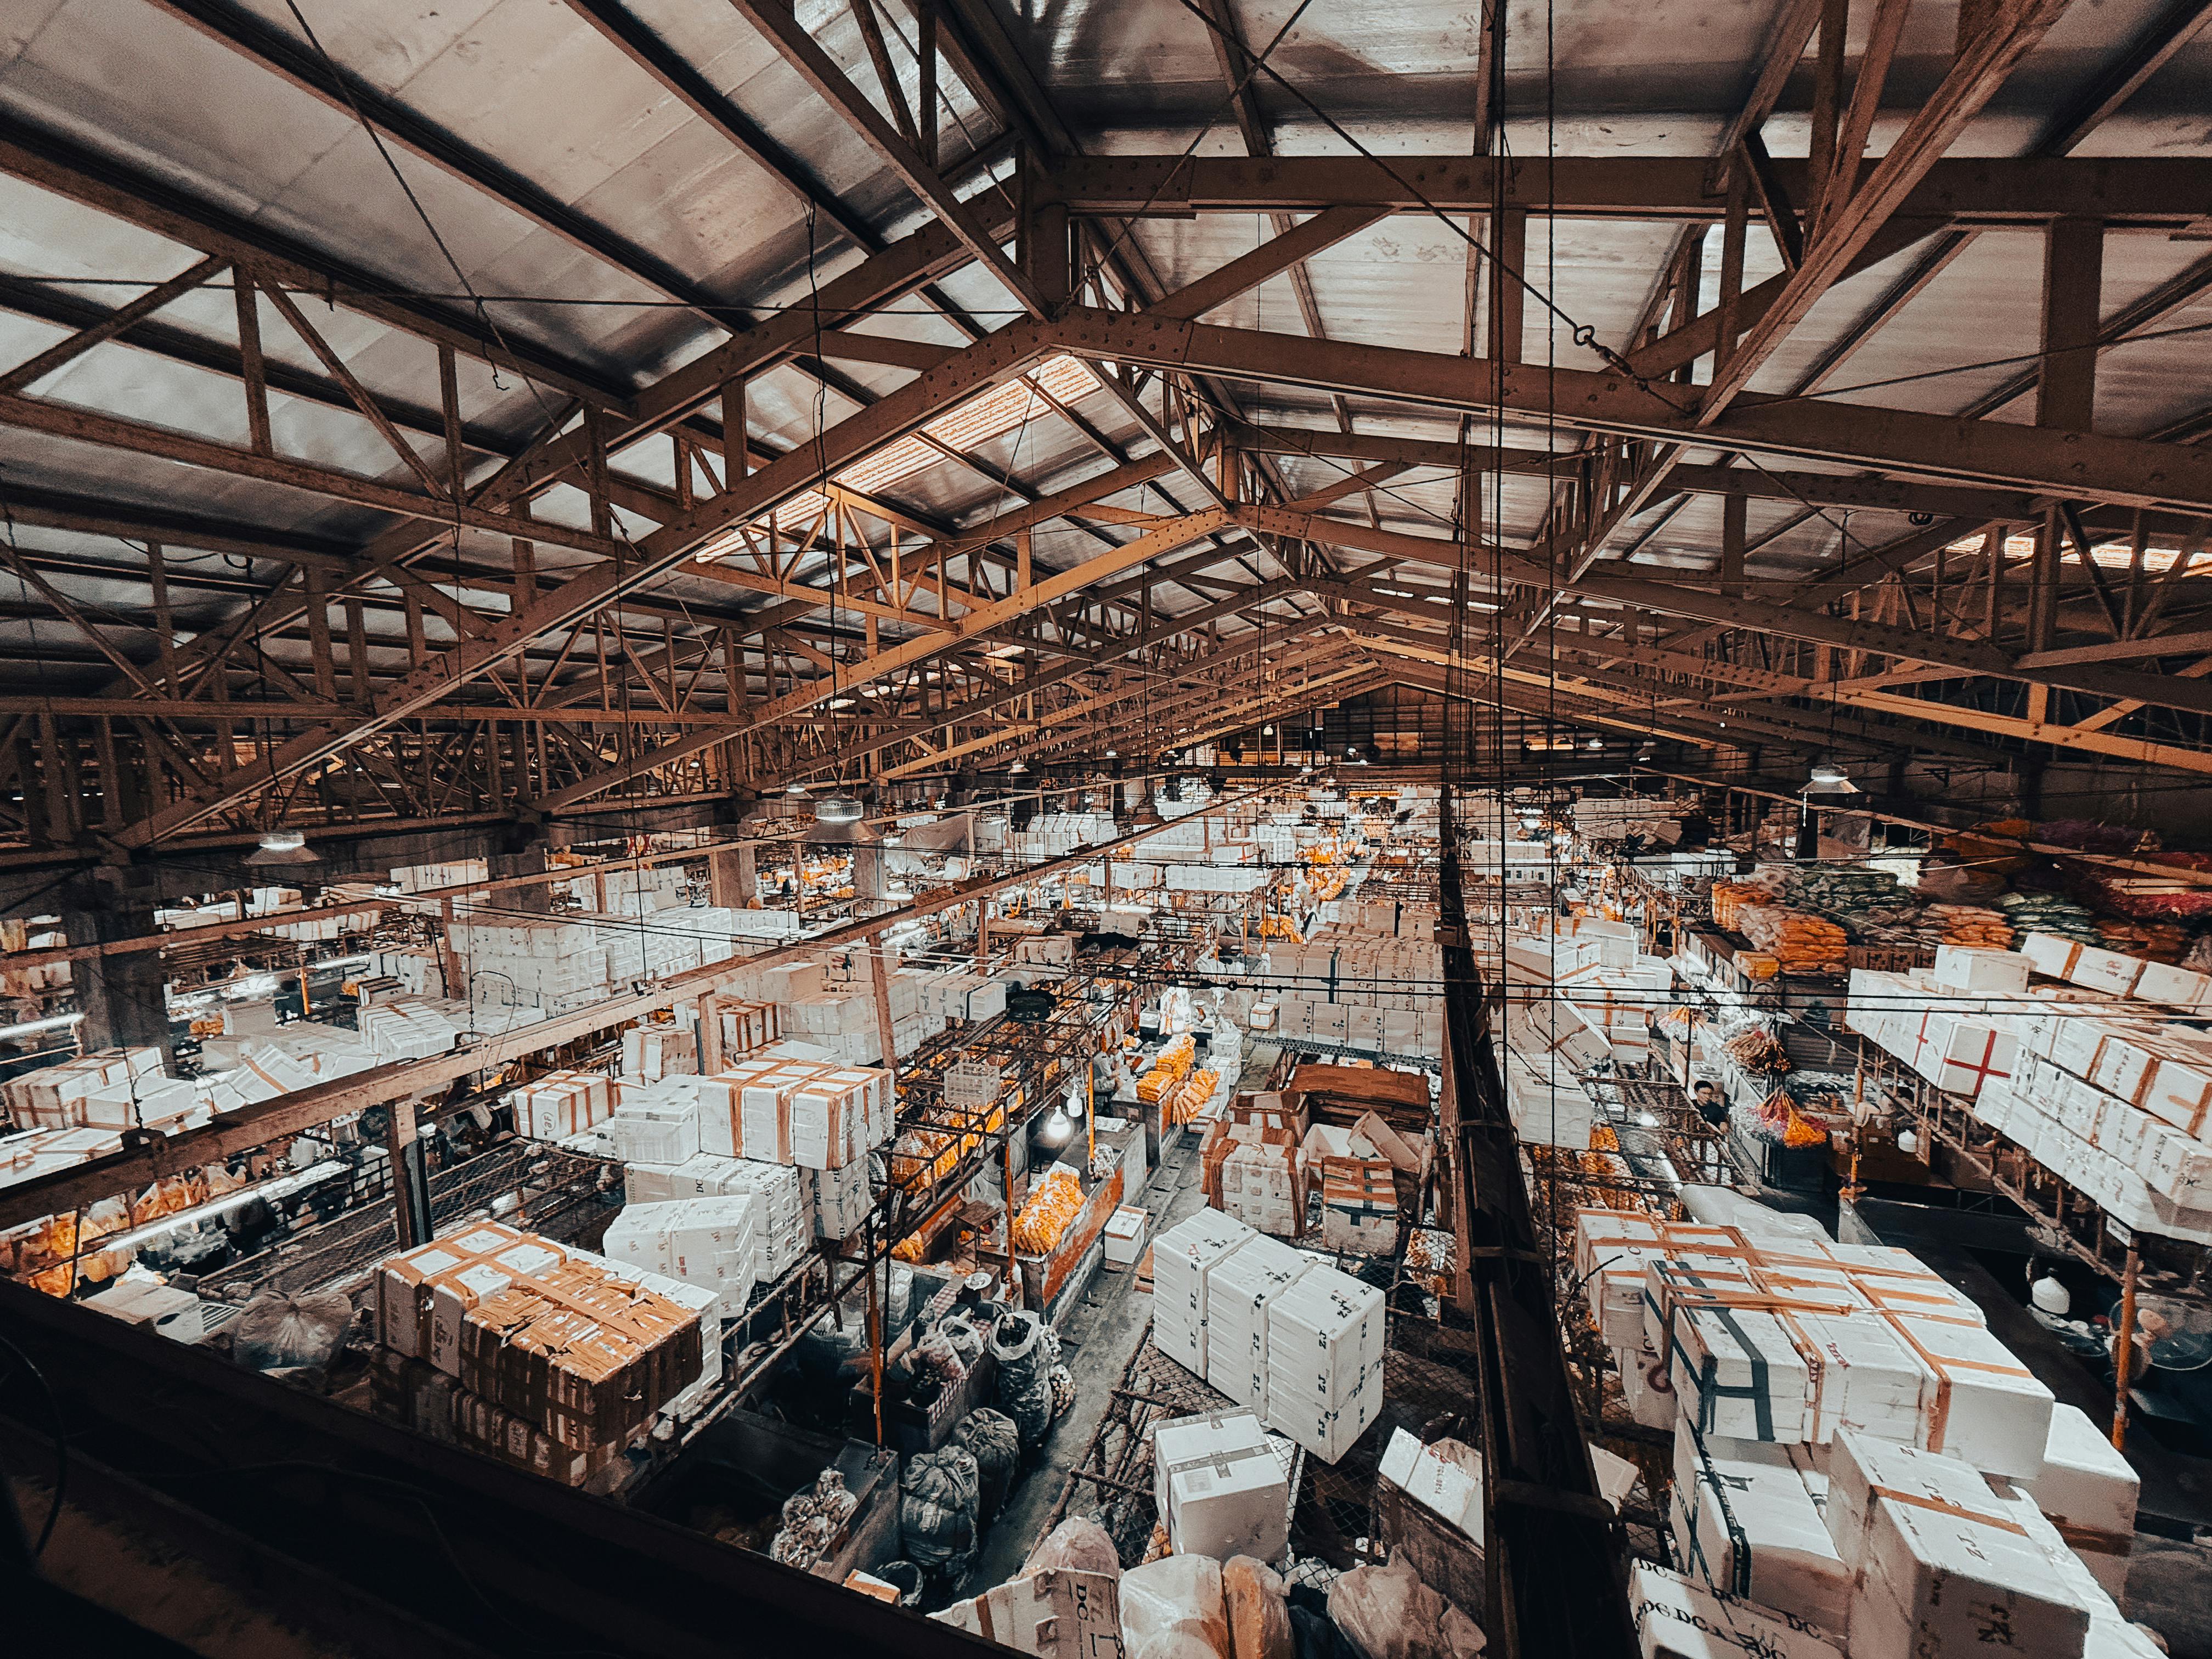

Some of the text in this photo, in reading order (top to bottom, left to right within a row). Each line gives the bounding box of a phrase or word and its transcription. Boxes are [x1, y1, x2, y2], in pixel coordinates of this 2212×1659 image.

[695, 1179, 704, 1193] DC
[1190, 1292, 1197, 1310] ZJ
[1253, 1333, 1260, 1351] ZJ
[1318, 1329, 1327, 1350] ZJ
[1253, 1373, 1260, 1392] ZJ
[1318, 1374, 1326, 1394] ZJ
[1076, 1582, 1088, 1621] DC
[1672, 1606, 1709, 1632] DC
